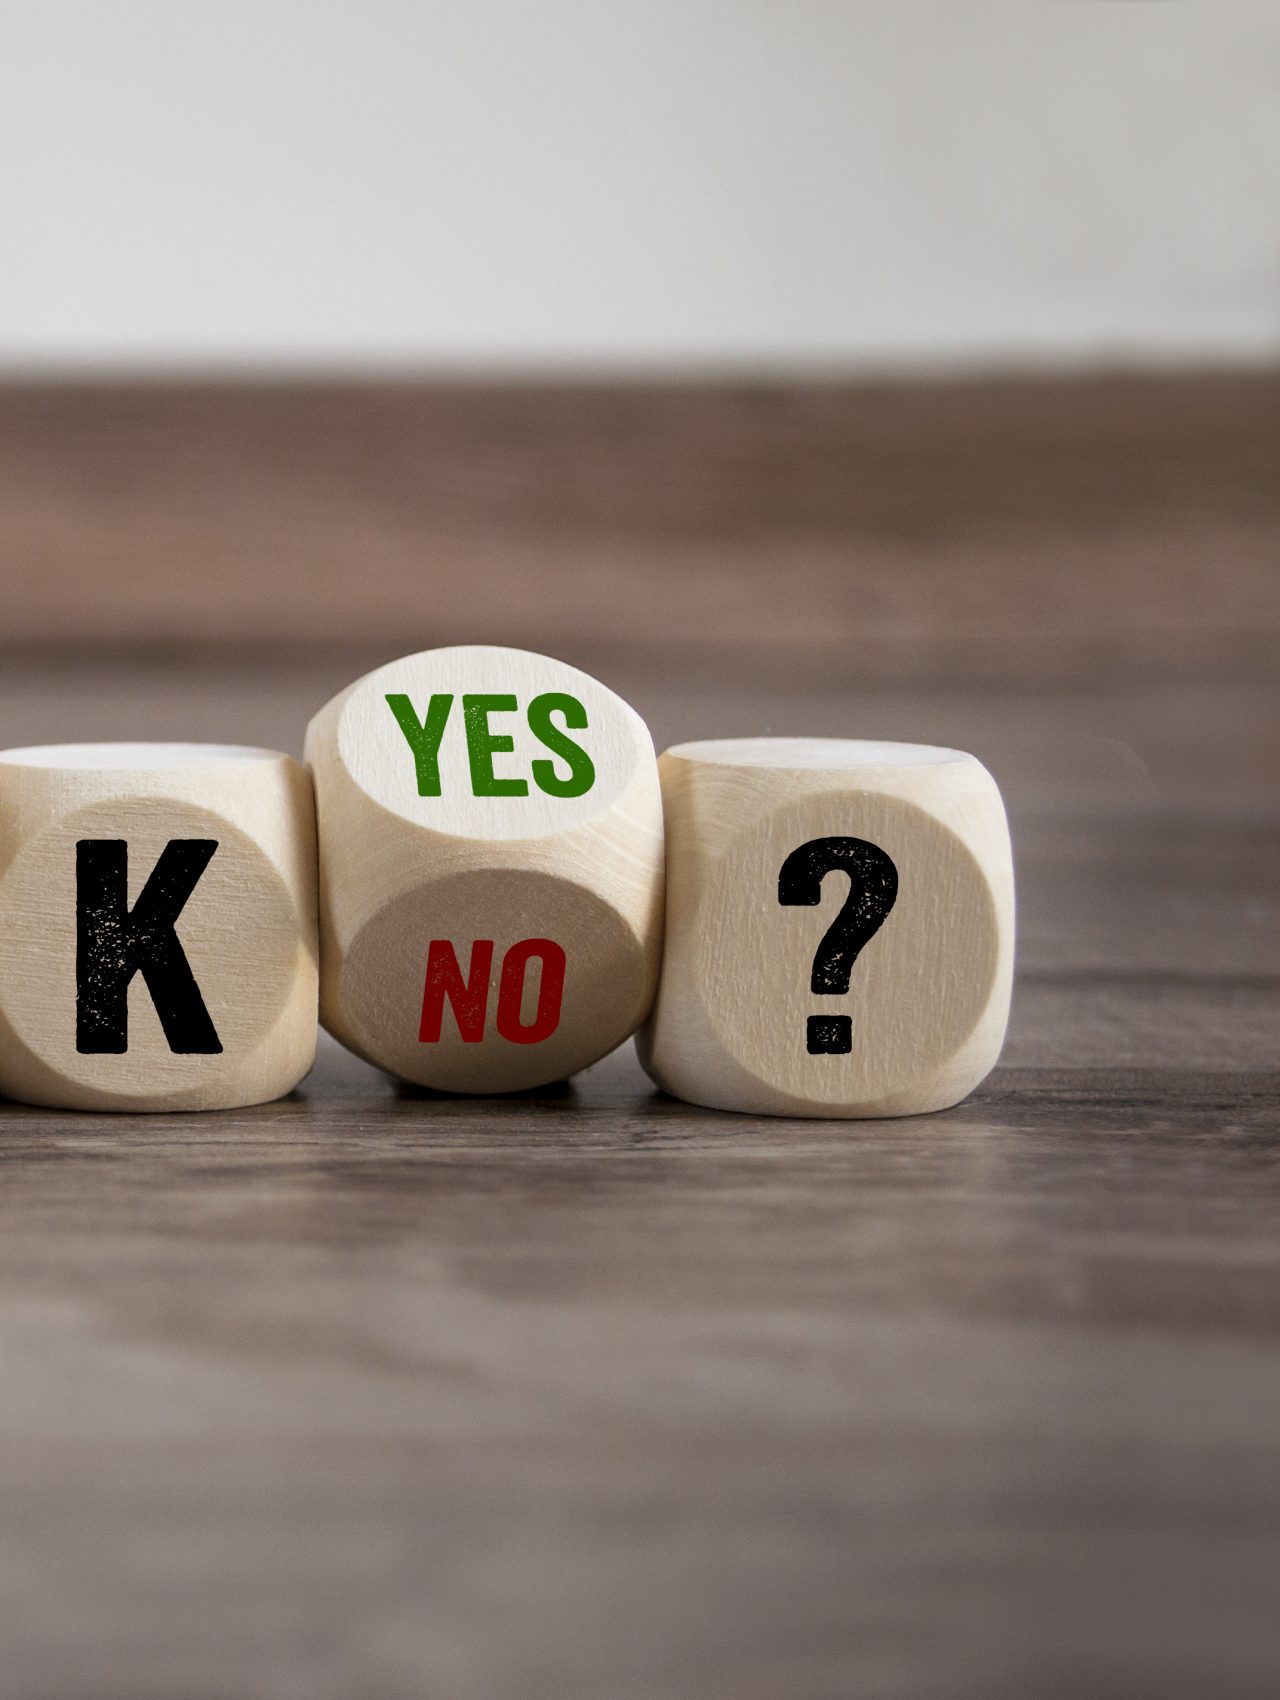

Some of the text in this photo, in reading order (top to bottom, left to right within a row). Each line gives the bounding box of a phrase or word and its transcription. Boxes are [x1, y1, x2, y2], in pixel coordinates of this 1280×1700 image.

[385, 693, 595, 798] YES
[419, 939, 567, 1044] NO
[778, 837, 898, 1054] ?
